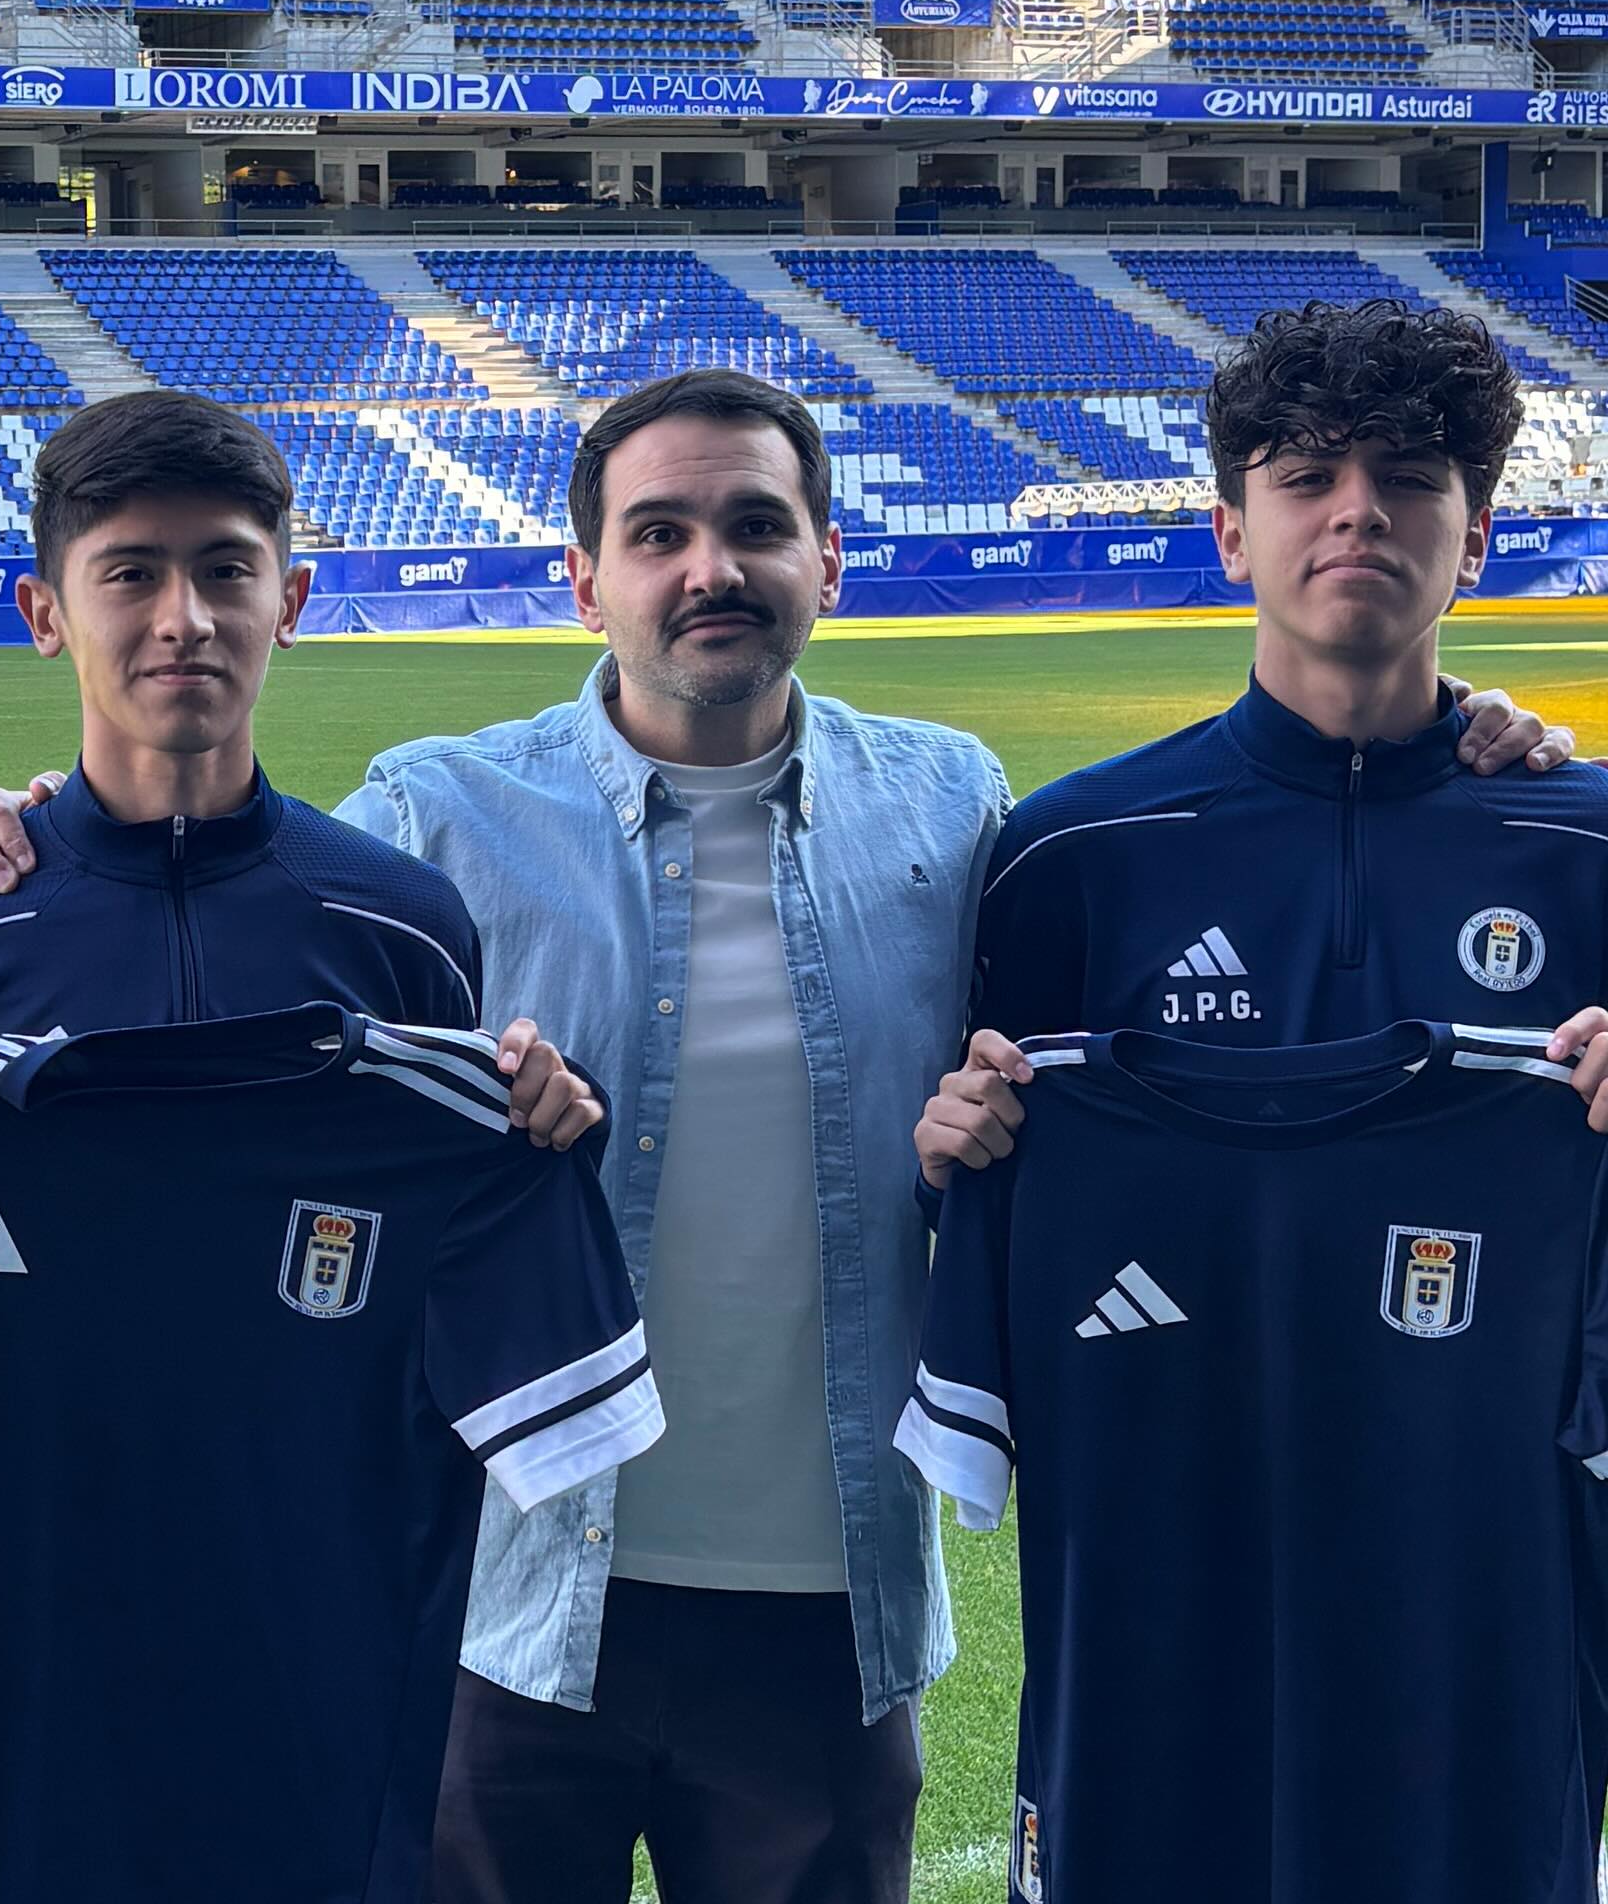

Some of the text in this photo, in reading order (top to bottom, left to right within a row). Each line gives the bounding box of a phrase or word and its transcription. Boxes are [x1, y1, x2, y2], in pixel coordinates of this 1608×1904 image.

[353, 73, 529, 110] INDIBA
[612, 76, 765, 101] LA PALOMA
[1064, 84, 1158, 107] vitasana
[613, 104, 679, 114] VERMOUTH
[684, 104, 730, 115] SOLERA
[1247, 91, 1472, 118] HYUNDAI Asturdai
